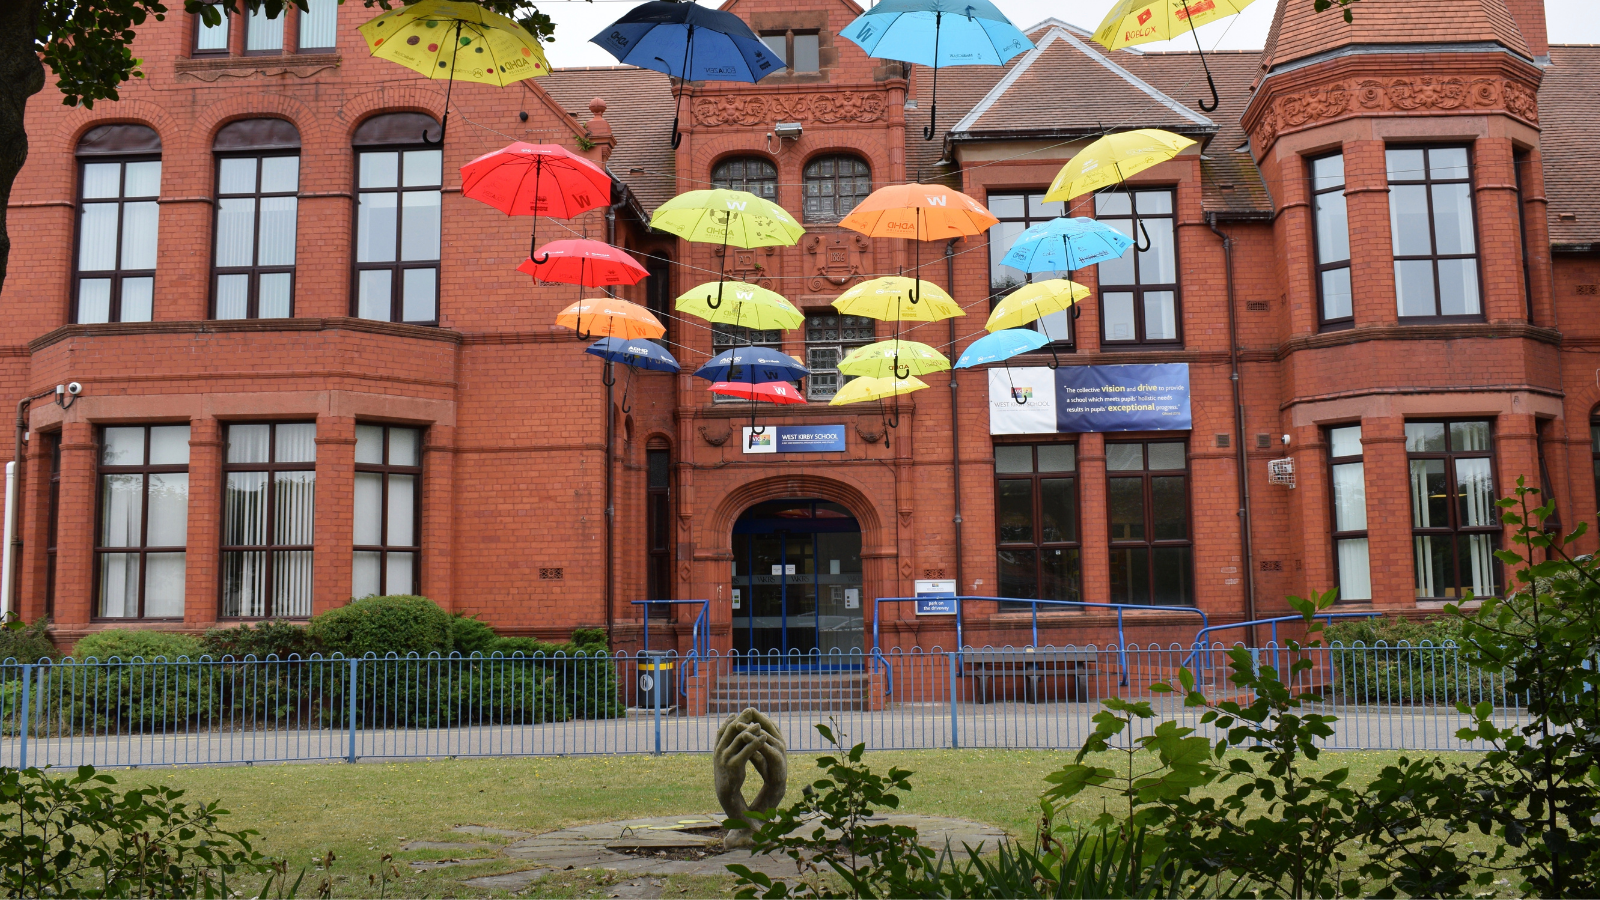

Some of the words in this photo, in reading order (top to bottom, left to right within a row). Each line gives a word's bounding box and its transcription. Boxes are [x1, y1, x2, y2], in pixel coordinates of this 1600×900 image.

[1125, 26, 1156, 42] ROBLOX
[926, 194, 946, 206] W
[726, 200, 747, 211] W
[739, 256, 752, 265] AD
[830, 252, 844, 262] 1886
[736, 292, 754, 300] W
[774, 386, 786, 395] W
[1138, 384, 1157, 392] drive
[1108, 403, 1155, 413] exceptional
